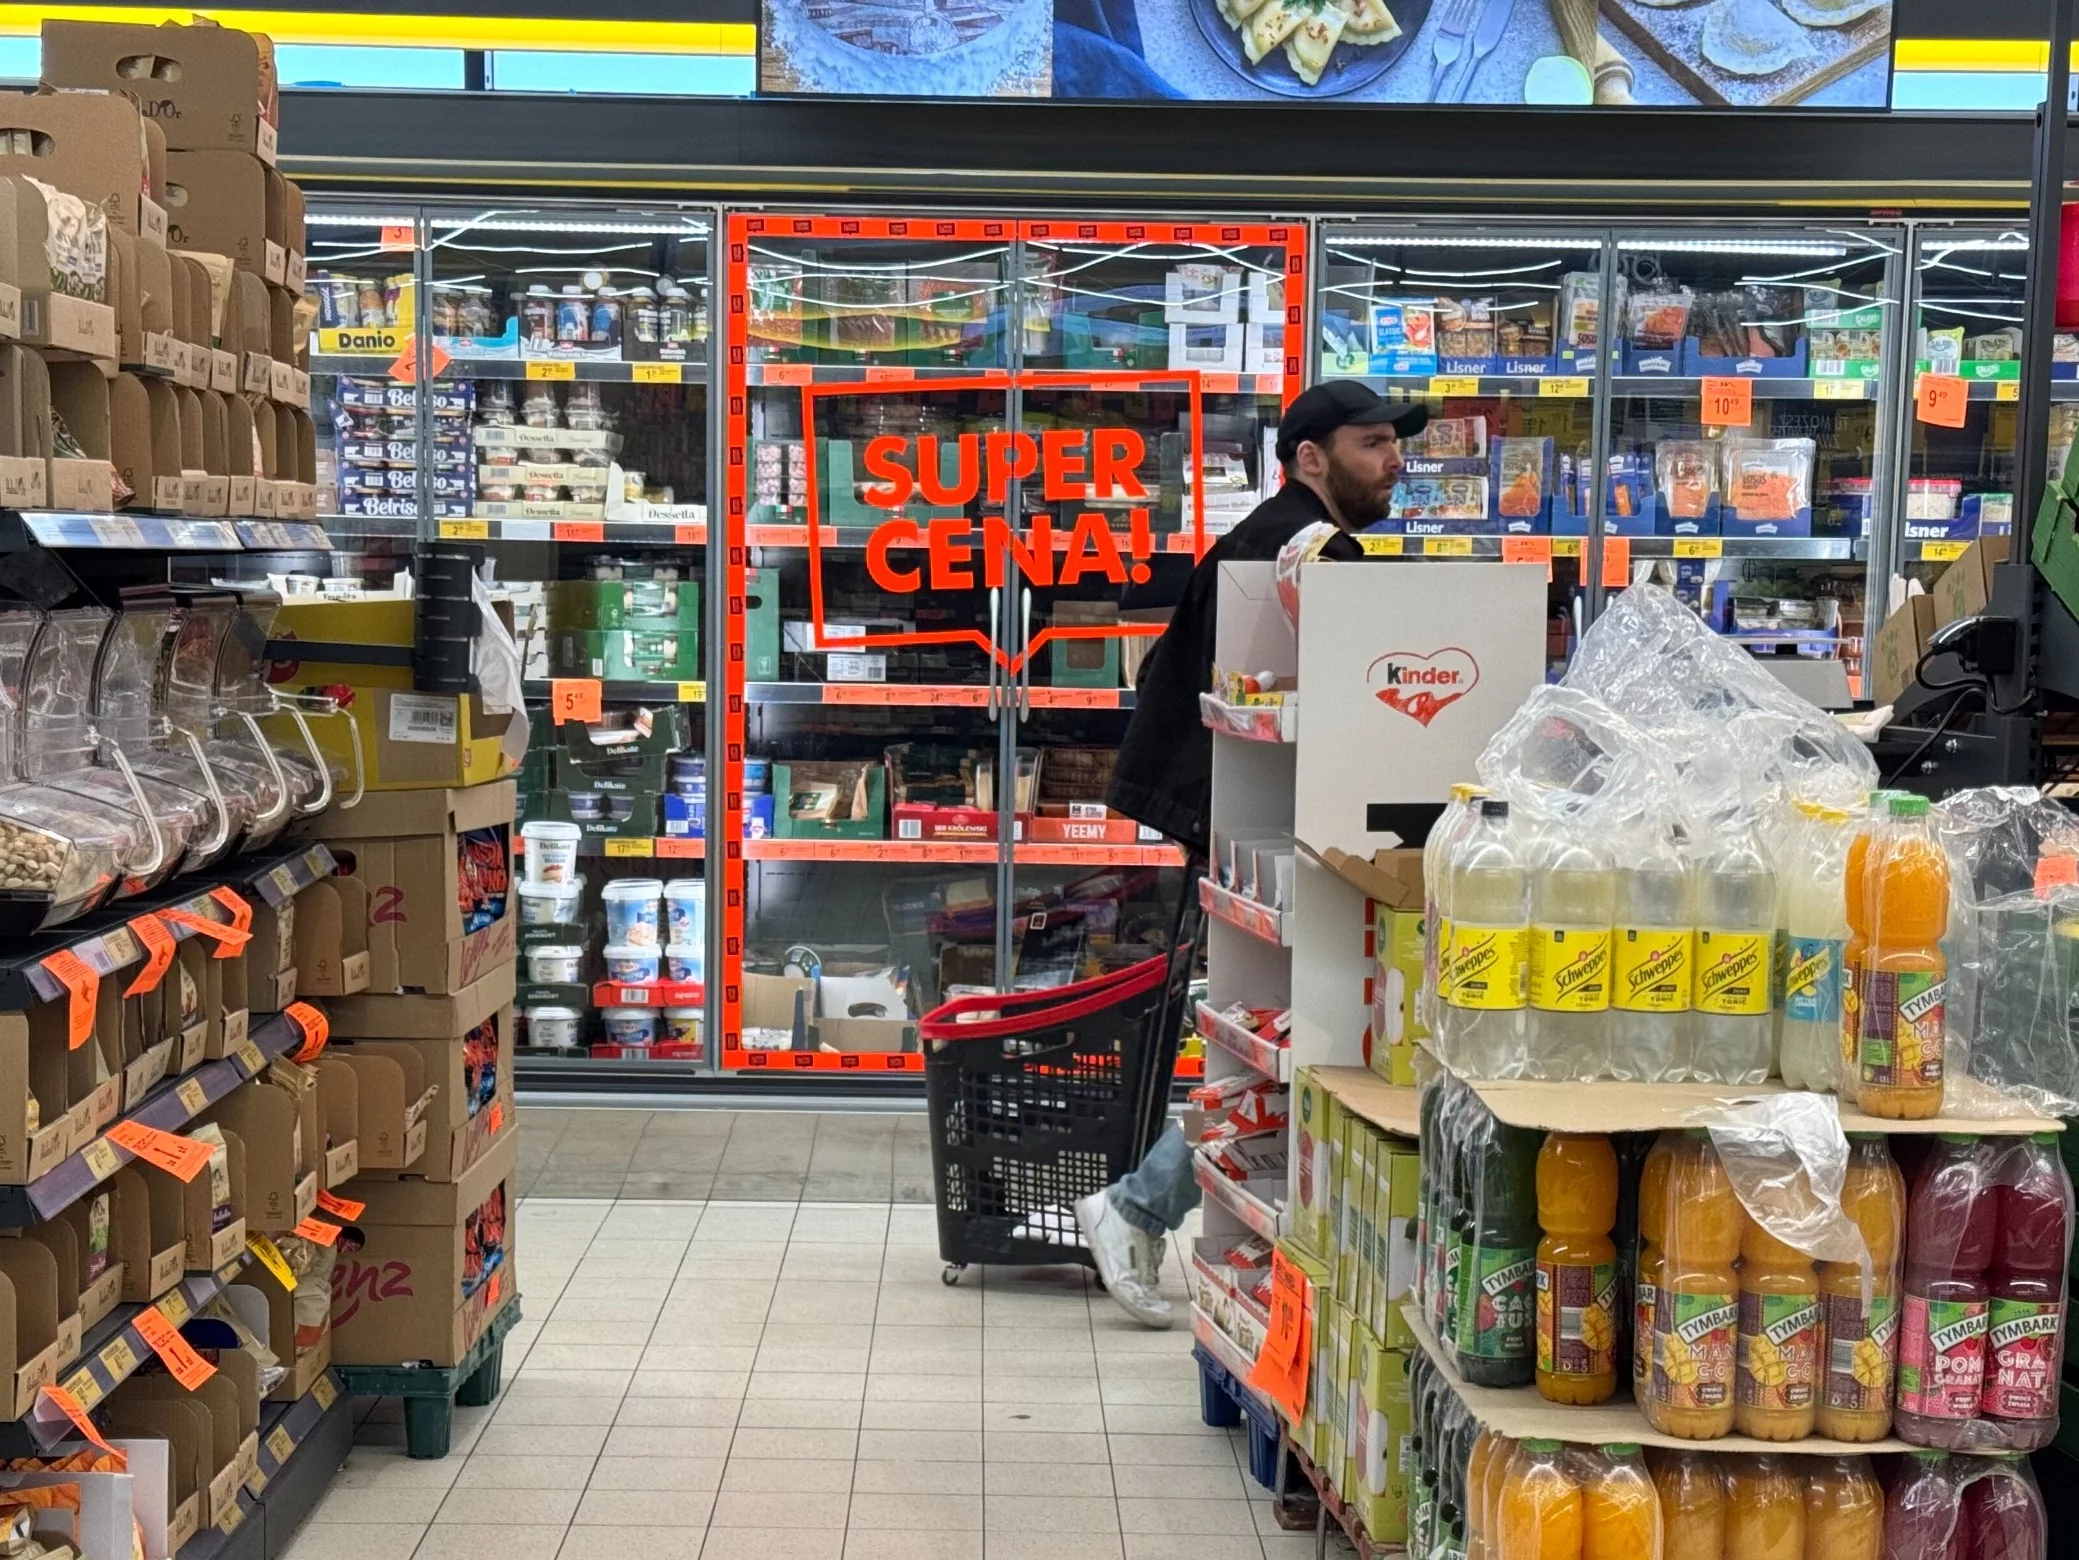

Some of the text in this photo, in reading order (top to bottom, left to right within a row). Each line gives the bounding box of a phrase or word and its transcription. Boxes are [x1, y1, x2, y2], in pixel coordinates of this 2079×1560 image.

[338, 330, 396, 349] Danio
[1446, 361, 1487, 374] Lisner
[1506, 360, 1547, 374] Lisner
[864, 427, 1148, 509] SUPER
[1406, 460, 1444, 474] Lisner
[1406, 521, 1444, 535] Lisner
[1904, 521, 1950, 538] isner
[865, 507, 1152, 593] CENA!
[606, 745, 640, 756] Delikate
[593, 781, 627, 790] Delikate
[586, 824, 619, 834] Delikate
[1062, 824, 1107, 839] YEEMY
[1701, 949, 1758, 995] Schweppes
[1991, 1316, 2058, 1344] TYMBARK
[1997, 1350, 2047, 1370] GRA
[1997, 1370, 2047, 1389] NAT
